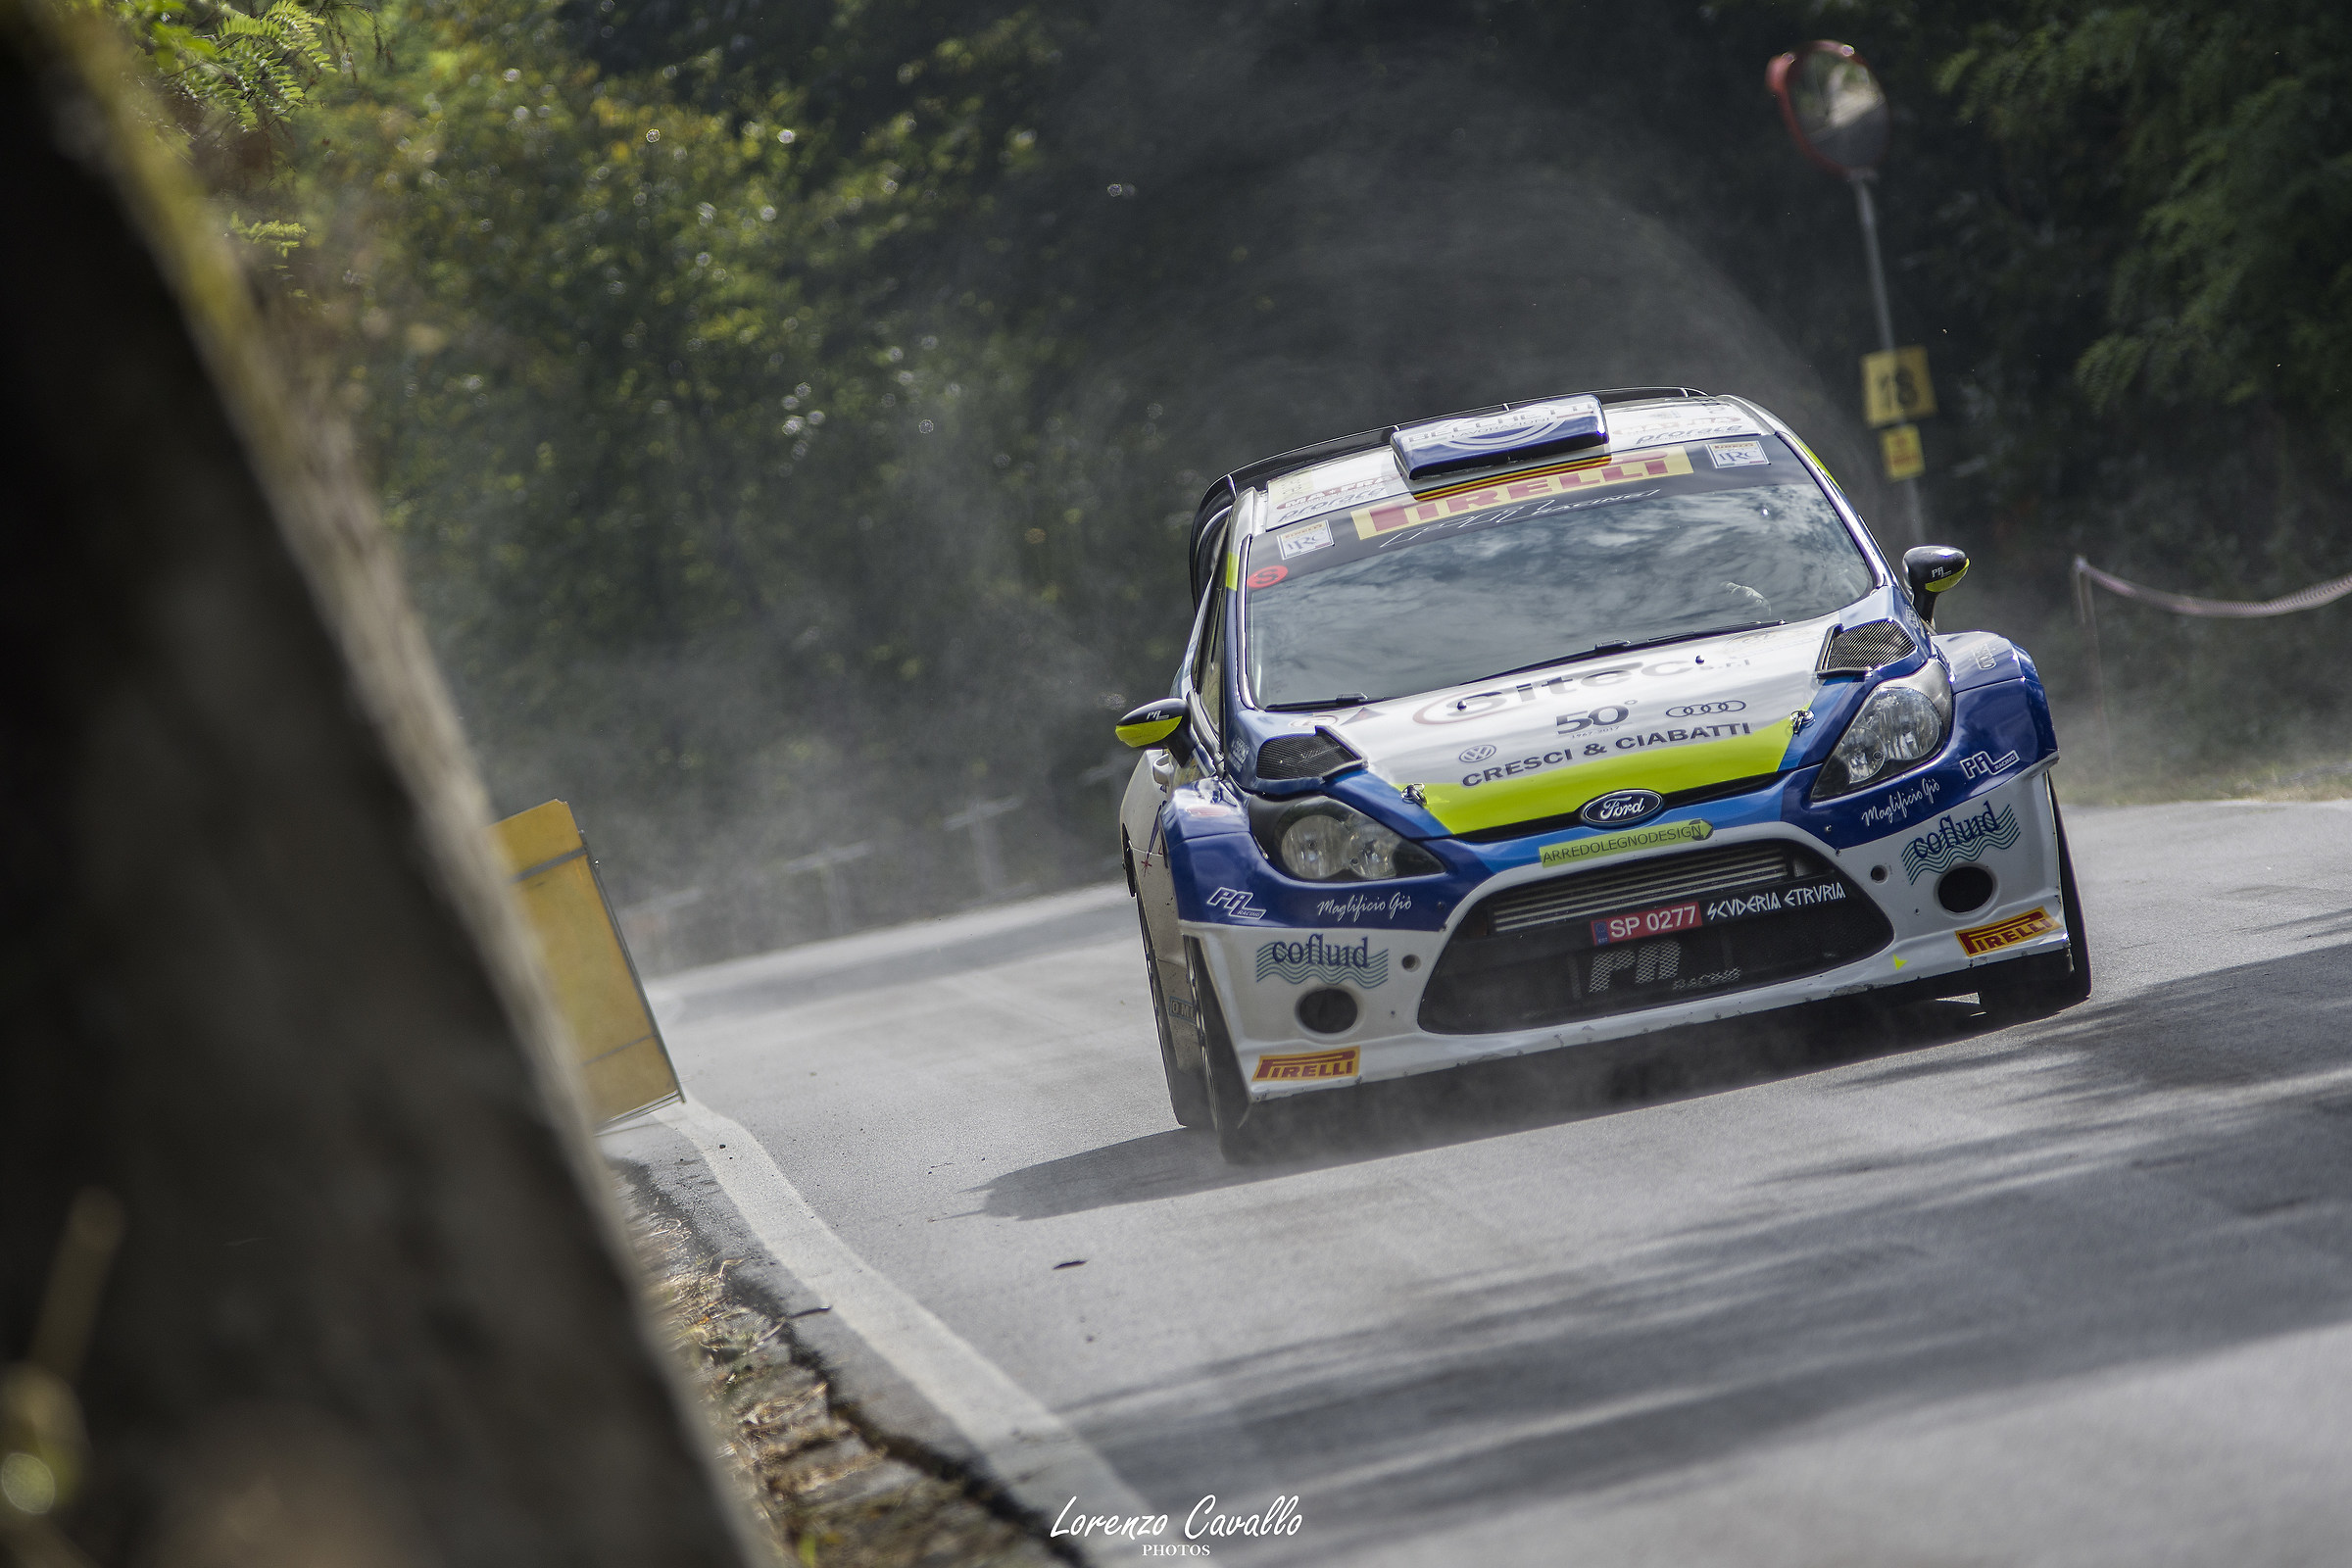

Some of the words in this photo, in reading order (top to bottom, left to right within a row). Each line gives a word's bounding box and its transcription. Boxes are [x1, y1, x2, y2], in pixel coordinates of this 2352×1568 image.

[1462, 748, 1574, 787] CRESCI
[1583, 743, 1608, 757] &
[1615, 722, 1751, 750] CIABATTI
[1599, 796, 1645, 820] Ford
[1861, 790, 1923, 827] Maglificio
[1922, 778, 1940, 804] Giò
[1543, 824, 1702, 863] ARREDOLEGNODESIGN
[1237, 909, 1261, 918] RACING
[1317, 894, 1386, 923] Maglificio
[1388, 892, 1412, 919] Giò
[1610, 916, 1641, 938] SP
[1646, 905, 1696, 932] 0277
[1959, 910, 2053, 956] PIRELLI
[1172, 1000, 1195, 1020] OM
[1256, 1050, 1356, 1079] PIRELLI
